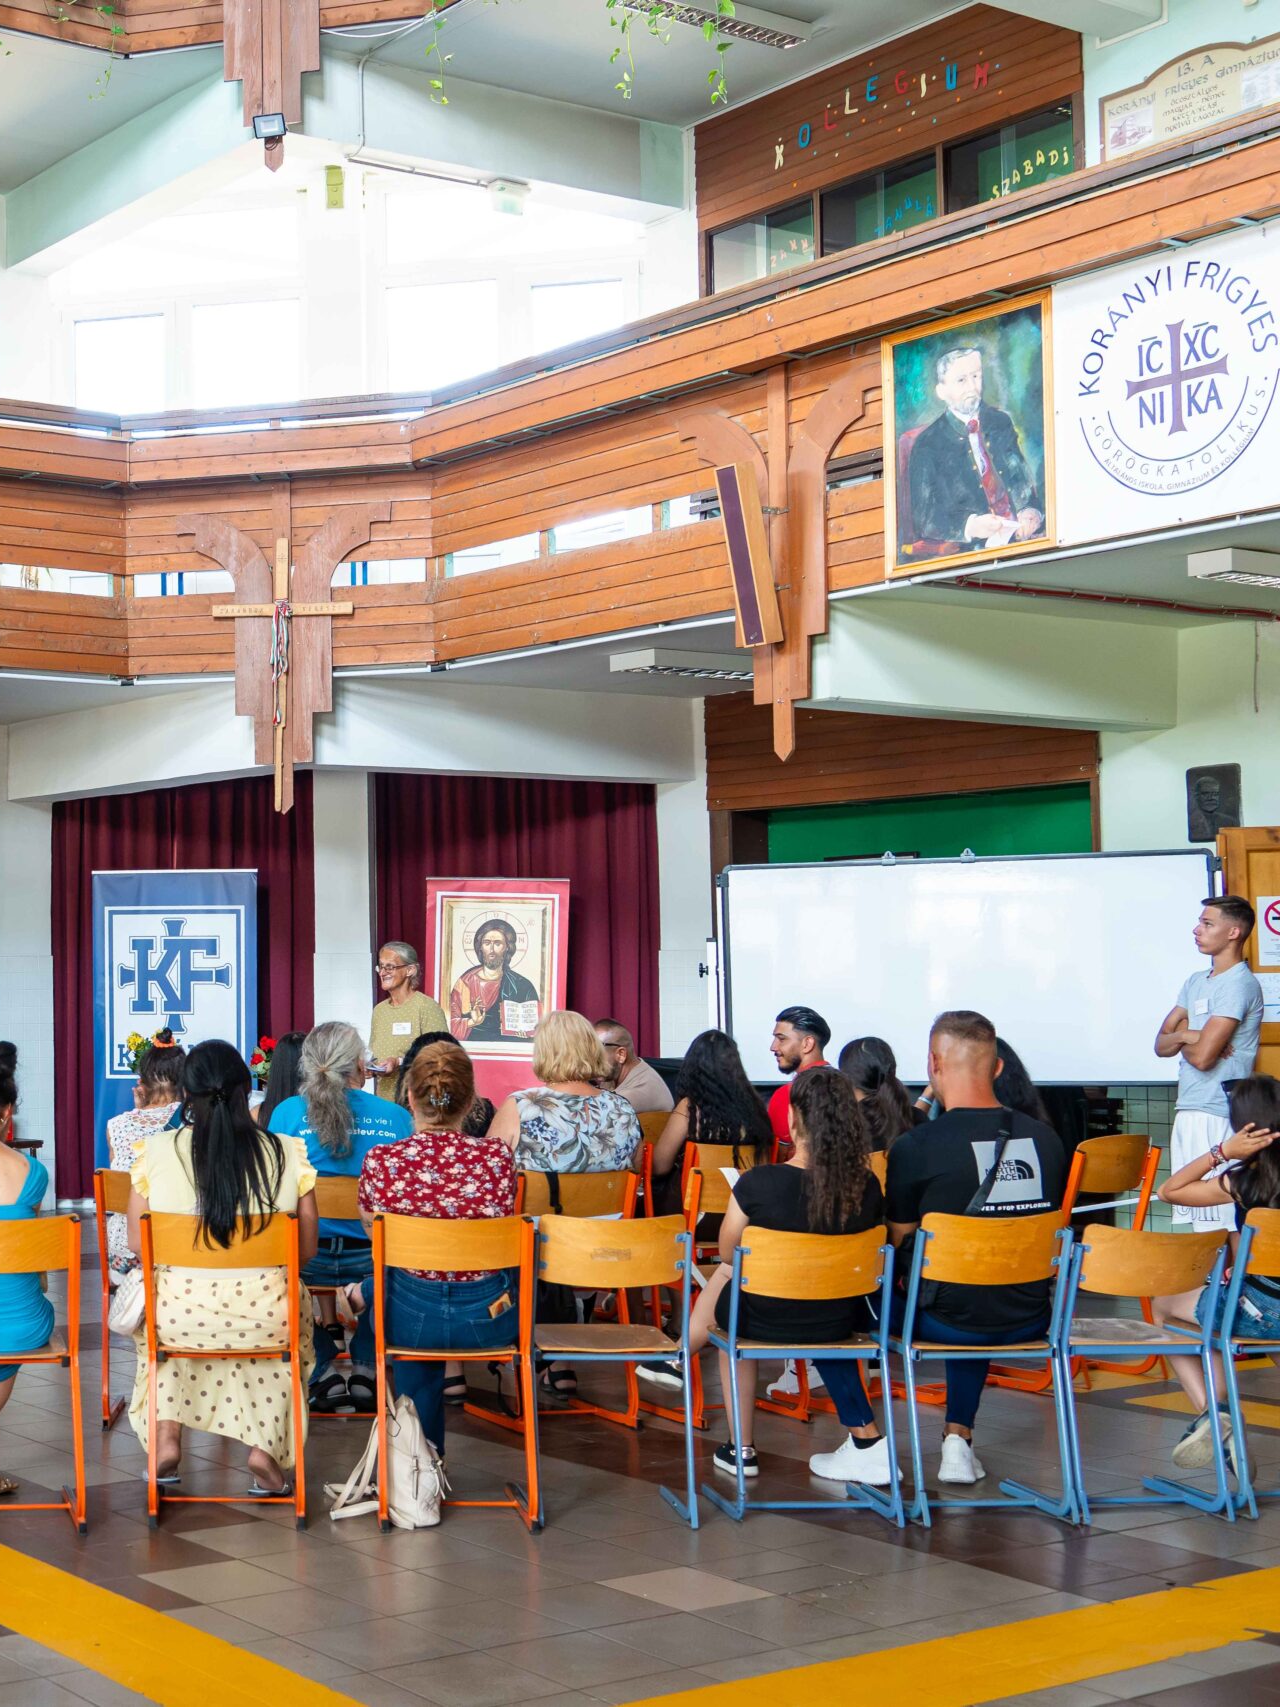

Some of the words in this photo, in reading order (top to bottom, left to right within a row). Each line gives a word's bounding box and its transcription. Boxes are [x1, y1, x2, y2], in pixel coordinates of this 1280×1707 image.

[1078, 266, 1171, 396] KORÁNYI
[1184, 261, 1278, 352] FRIGYES
[985, 1166, 1016, 1176] NRTH
